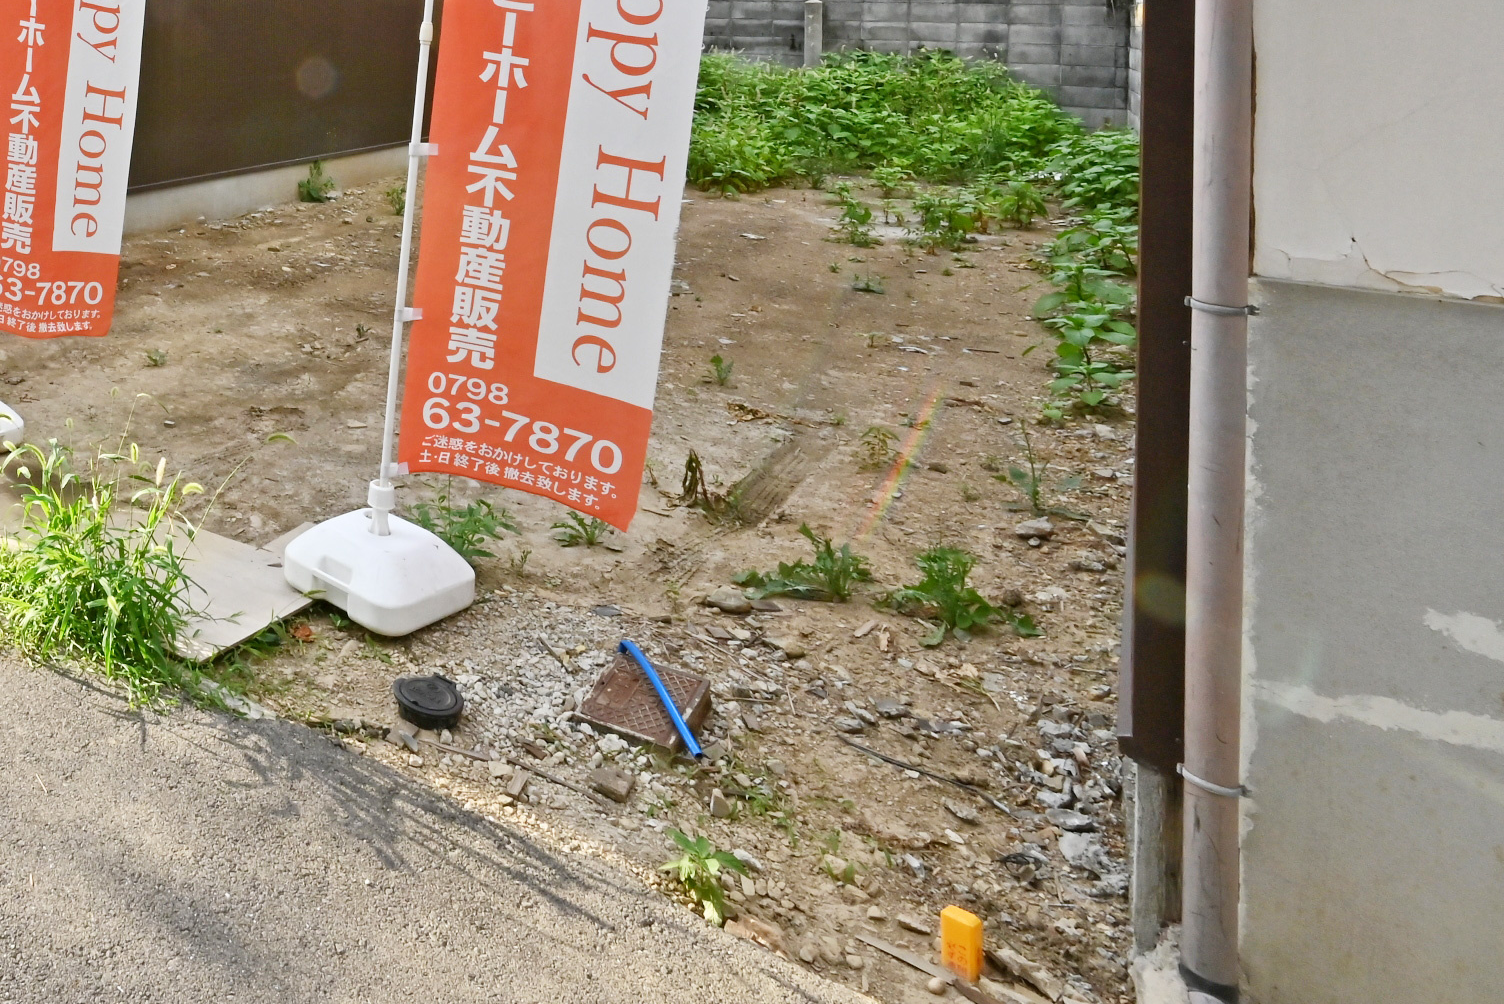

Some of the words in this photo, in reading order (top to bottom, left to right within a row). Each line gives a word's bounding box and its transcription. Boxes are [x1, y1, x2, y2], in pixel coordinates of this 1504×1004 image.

[70, 80, 127, 239] Home
[571, 142, 667, 375] Home
[427, 371, 509, 405] 0798
[422, 397, 623, 475] 63-7870
[422, 434, 617, 499] ご迷惑をおかけしております。
